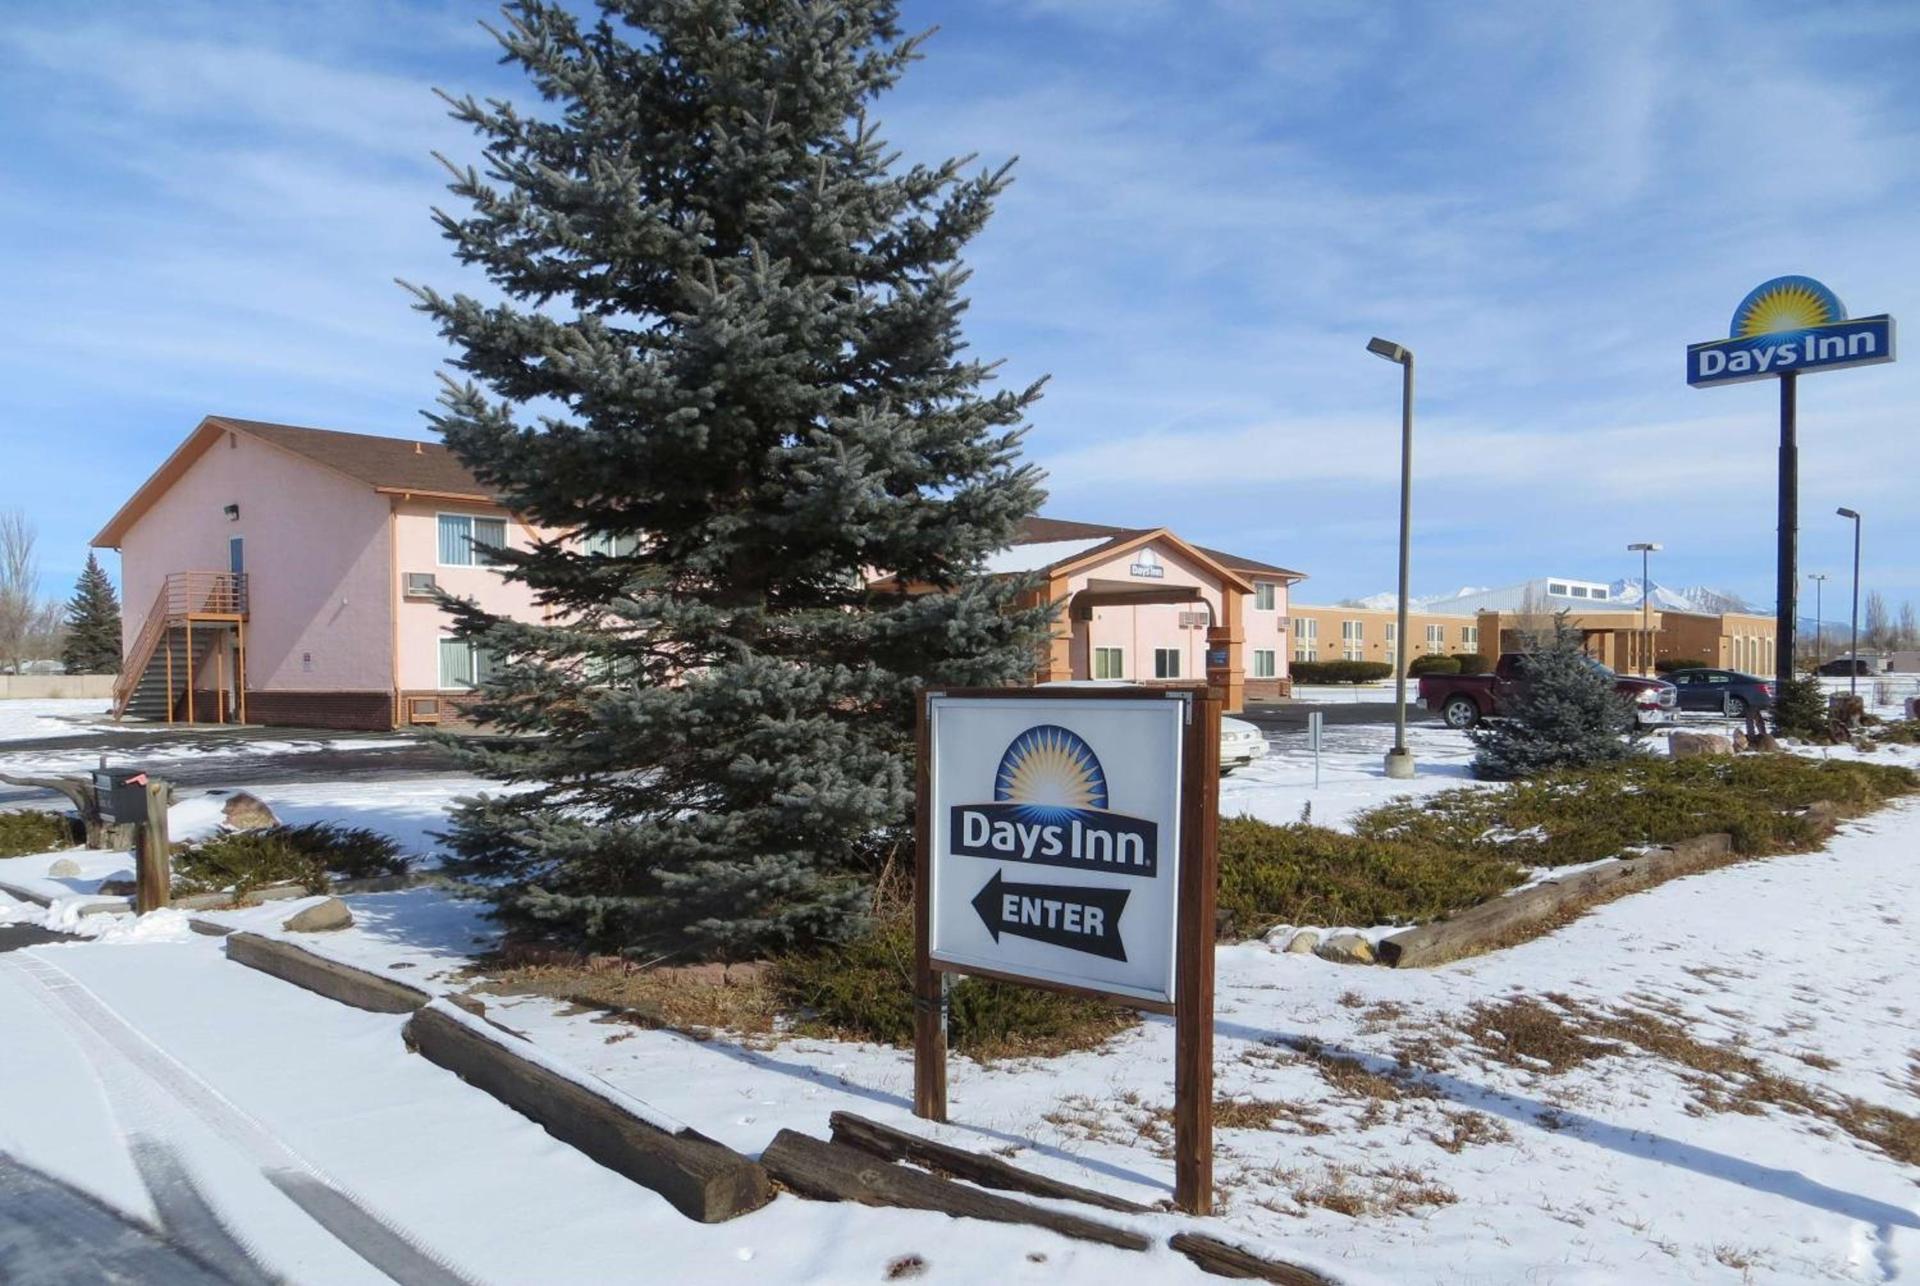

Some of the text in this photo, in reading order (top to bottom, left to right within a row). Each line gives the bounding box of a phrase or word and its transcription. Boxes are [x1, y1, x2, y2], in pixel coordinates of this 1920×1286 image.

[1699, 331, 1876, 377] Days Inn
[1132, 565, 1162, 577] Days Inn
[962, 811, 1145, 867] Days Inn
[1001, 893, 1105, 937] ENTER
